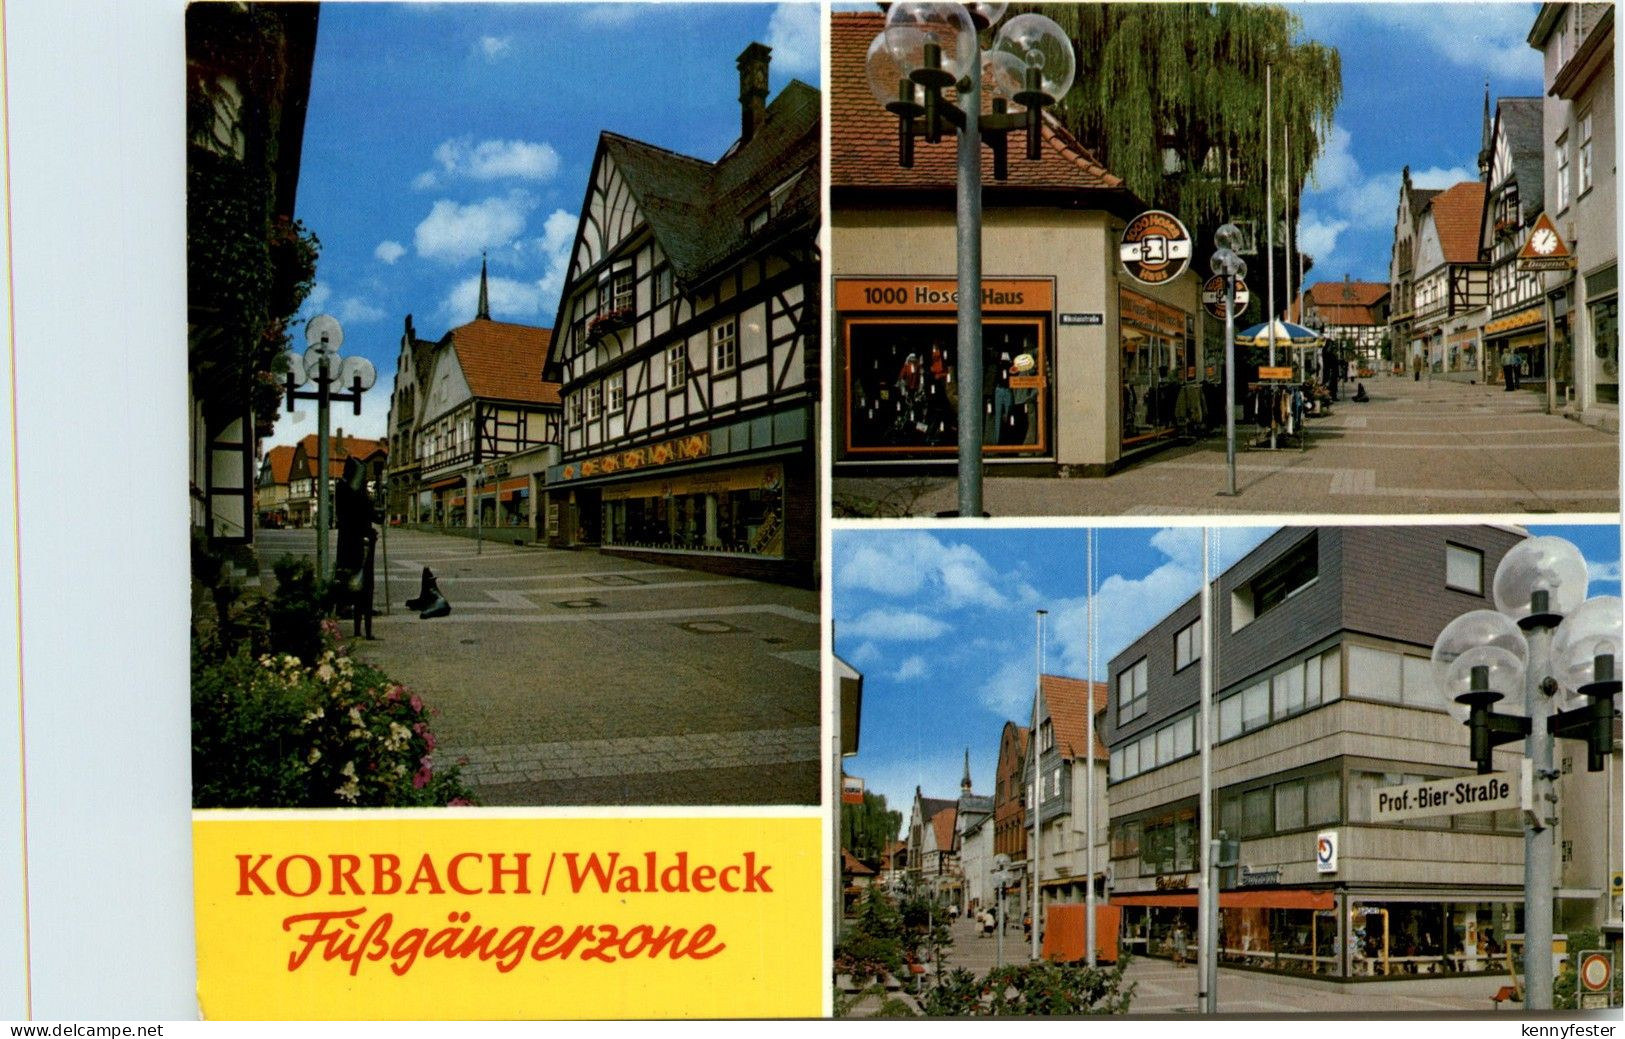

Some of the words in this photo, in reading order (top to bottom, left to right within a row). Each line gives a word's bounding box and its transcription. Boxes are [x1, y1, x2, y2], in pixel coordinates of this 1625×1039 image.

[1149, 214, 1180, 239] Hosen
[1138, 268, 1168, 282] Haus
[864, 287, 908, 305] 1000
[914, 286, 960, 304] Hose
[982, 288, 1025, 305] Haus
[1379, 778, 1509, 813] Prof.-Bier-Straße
